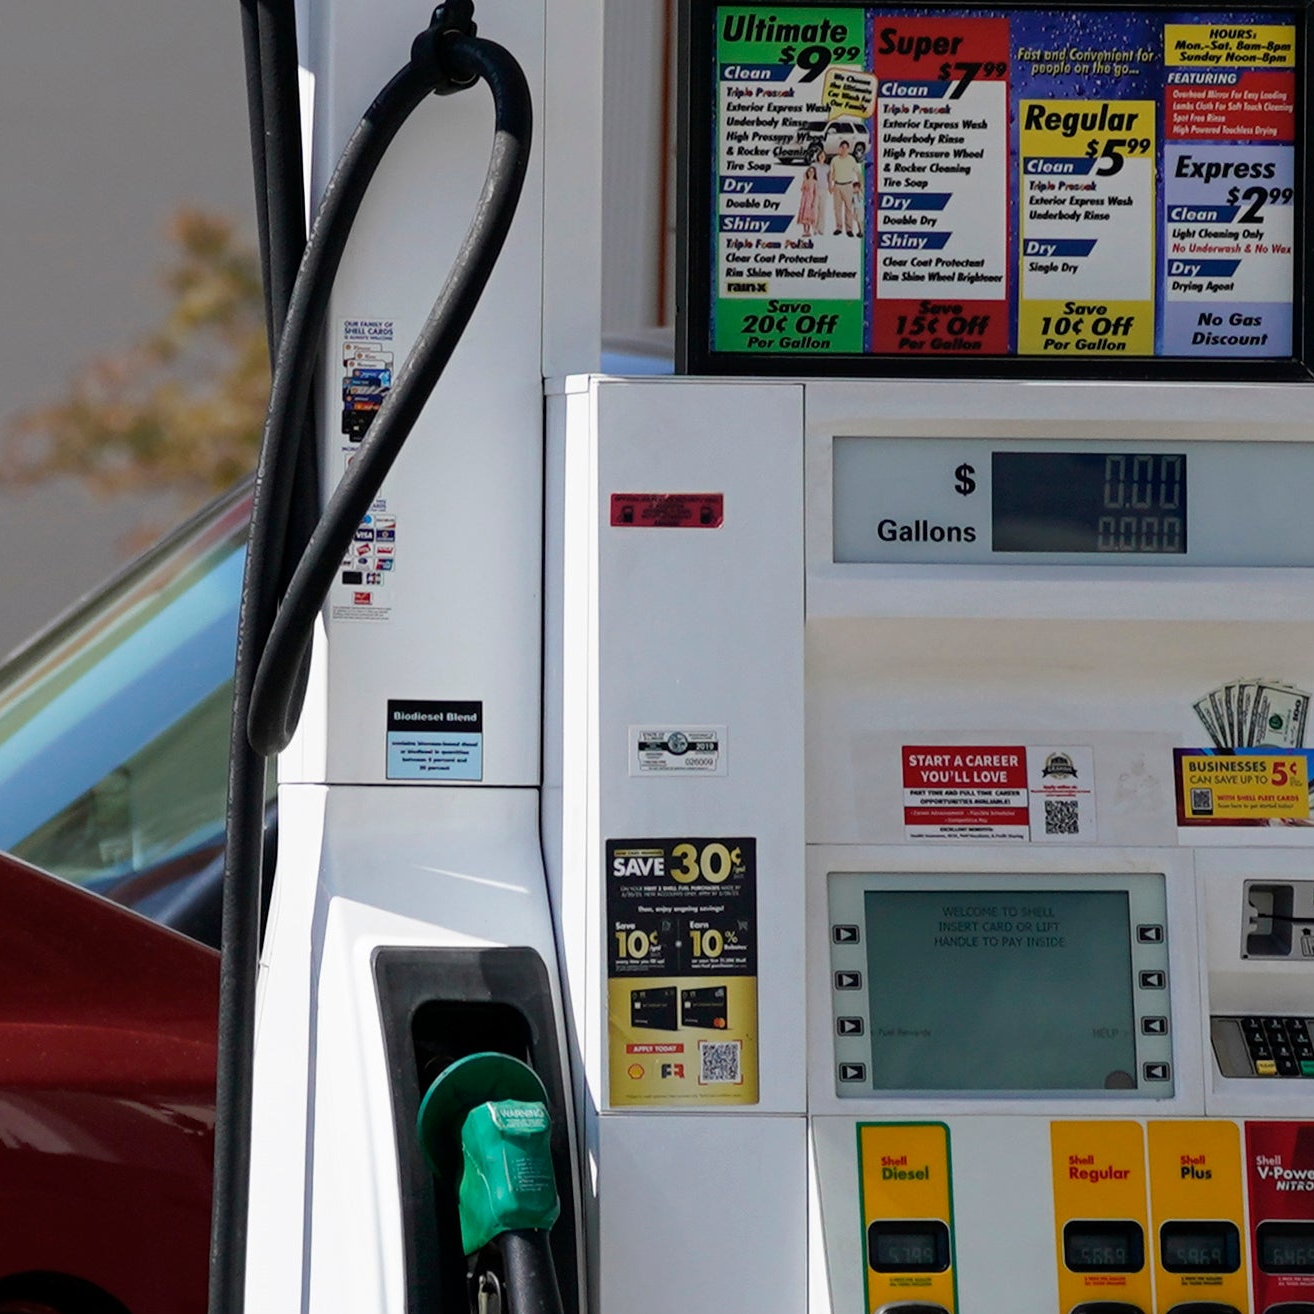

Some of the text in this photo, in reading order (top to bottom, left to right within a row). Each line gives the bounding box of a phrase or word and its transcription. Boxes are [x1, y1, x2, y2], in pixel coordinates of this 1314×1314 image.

[723, 14, 847, 43] Ultimate
[1209, 29, 1257, 39] HOURS:
[878, 28, 963, 61] Super
[1236, 41, 1291, 52] 8am-8pm
[1018, 48, 1154, 61] Fast and Convenient for
[1179, 52, 1287, 64] Sunday Noon-8pm
[724, 65, 771, 79] Clean
[1031, 62, 1140, 77] people on the go...
[1167, 72, 1237, 84] FEATURING
[881, 83, 928, 96] Clean
[1024, 103, 1139, 138] Regular
[1027, 159, 1074, 173] Clean
[1175, 155, 1276, 183] Express
[723, 179, 753, 193] Dry
[881, 195, 912, 210] Dry
[1171, 207, 1217, 221] Clean
[722, 217, 770, 232] Shiny
[881, 234, 927, 250] Shiny
[1026, 241, 1057, 257] Dry
[1171, 262, 1201, 276] Dry
[767, 300, 811, 313] Save
[919, 300, 963, 314] Save
[1064, 302, 1107, 315] Save
[741, 315, 839, 334] 20¢ Off
[896, 315, 990, 335] 15¢ Off
[1198, 313, 1262, 326] No Gas
[1041, 317, 1135, 336] 10¢ Off
[747, 337, 830, 349] Per Gallon
[899, 338, 981, 350] Per Gallon
[1043, 339, 1126, 351] Per Gallon
[1192, 332, 1268, 345] Discount
[954, 463, 976, 496] $
[877, 518, 976, 543] Gallons
[393, 711, 478, 722] Biodiesel Blend
[908, 755, 1018, 767] START A CAREER
[1189, 761, 1267, 772] BUSINESSES
[973, 771, 1007, 783] LOVE
[1189, 775, 1268, 785] CAN SAVE UP TO
[613, 858, 665, 877] SAVE
[942, 906, 1055, 918] WELCOME TO SHELL
[615, 922, 636, 930] Save
[689, 921, 710, 929] Earn
[939, 921, 1060, 932] INSERT CARD OR LIFT
[935, 936, 1065, 948] HANDLE TO PAY INSIDE
[655, 1045, 677, 1053] TODAY
[881, 1155, 907, 1166] Shell
[1069, 1155, 1094, 1165] Shell
[1181, 1155, 1205, 1165] Shell
[1256, 1155, 1281, 1165] Shell
[882, 1166, 929, 1180] Diesel
[1069, 1165, 1130, 1183] Regular
[1181, 1165, 1212, 1179] Plus
